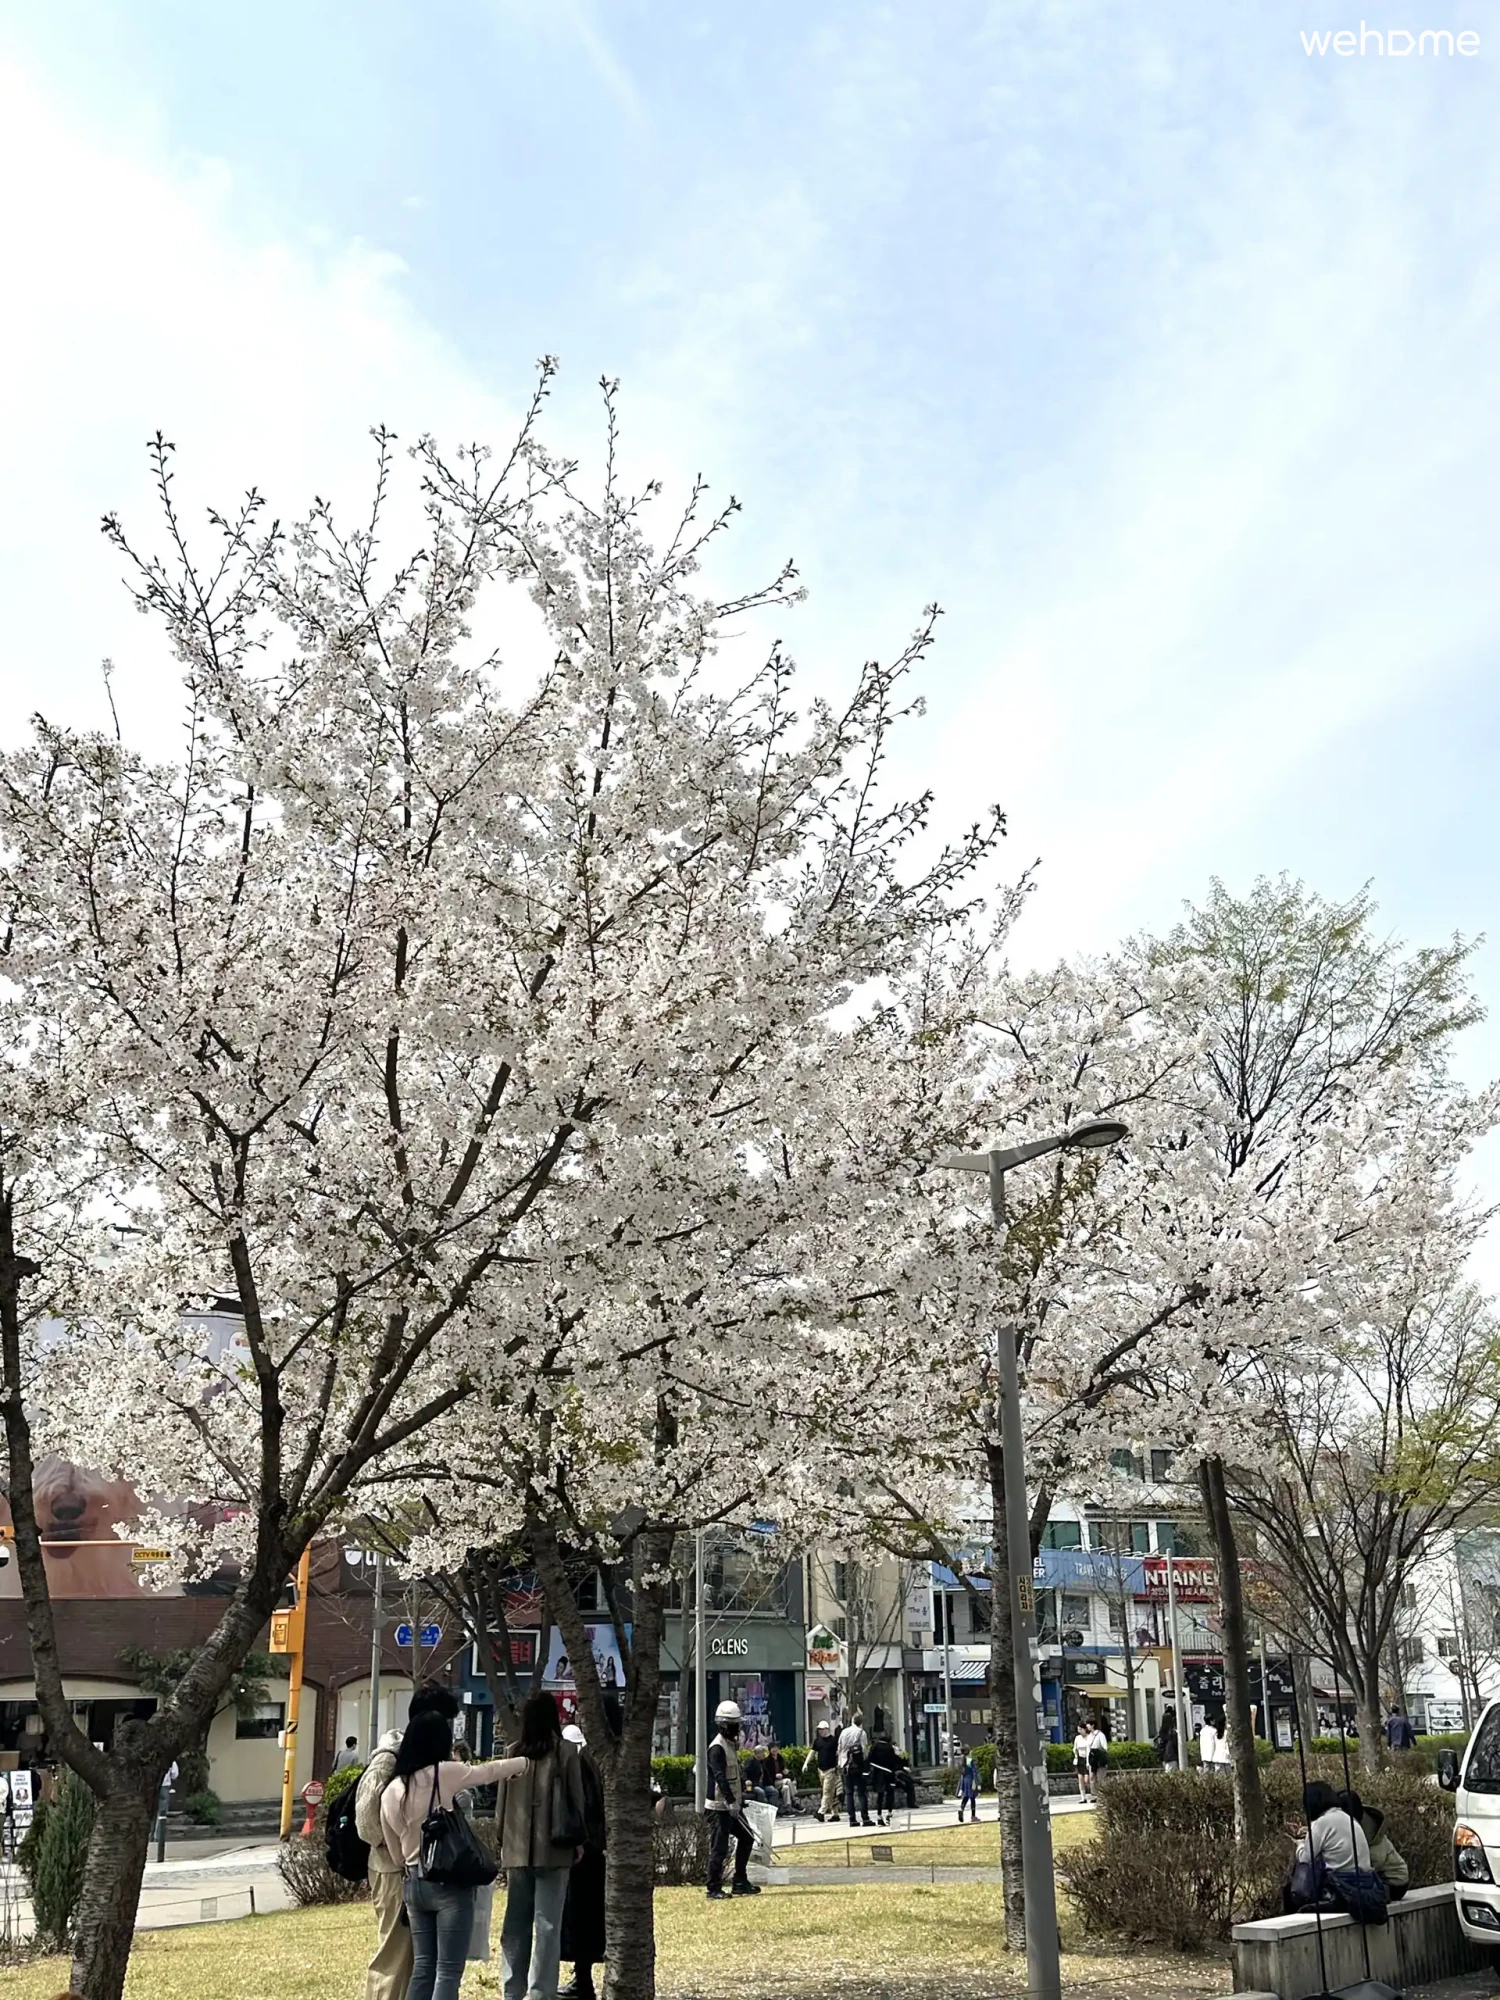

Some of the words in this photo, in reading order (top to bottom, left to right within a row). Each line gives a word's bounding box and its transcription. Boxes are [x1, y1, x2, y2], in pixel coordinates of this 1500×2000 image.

[1033, 1557, 1044, 1567] EL
[1033, 1568, 1045, 1578] ER
[712, 1638, 748, 1655] OLENS
